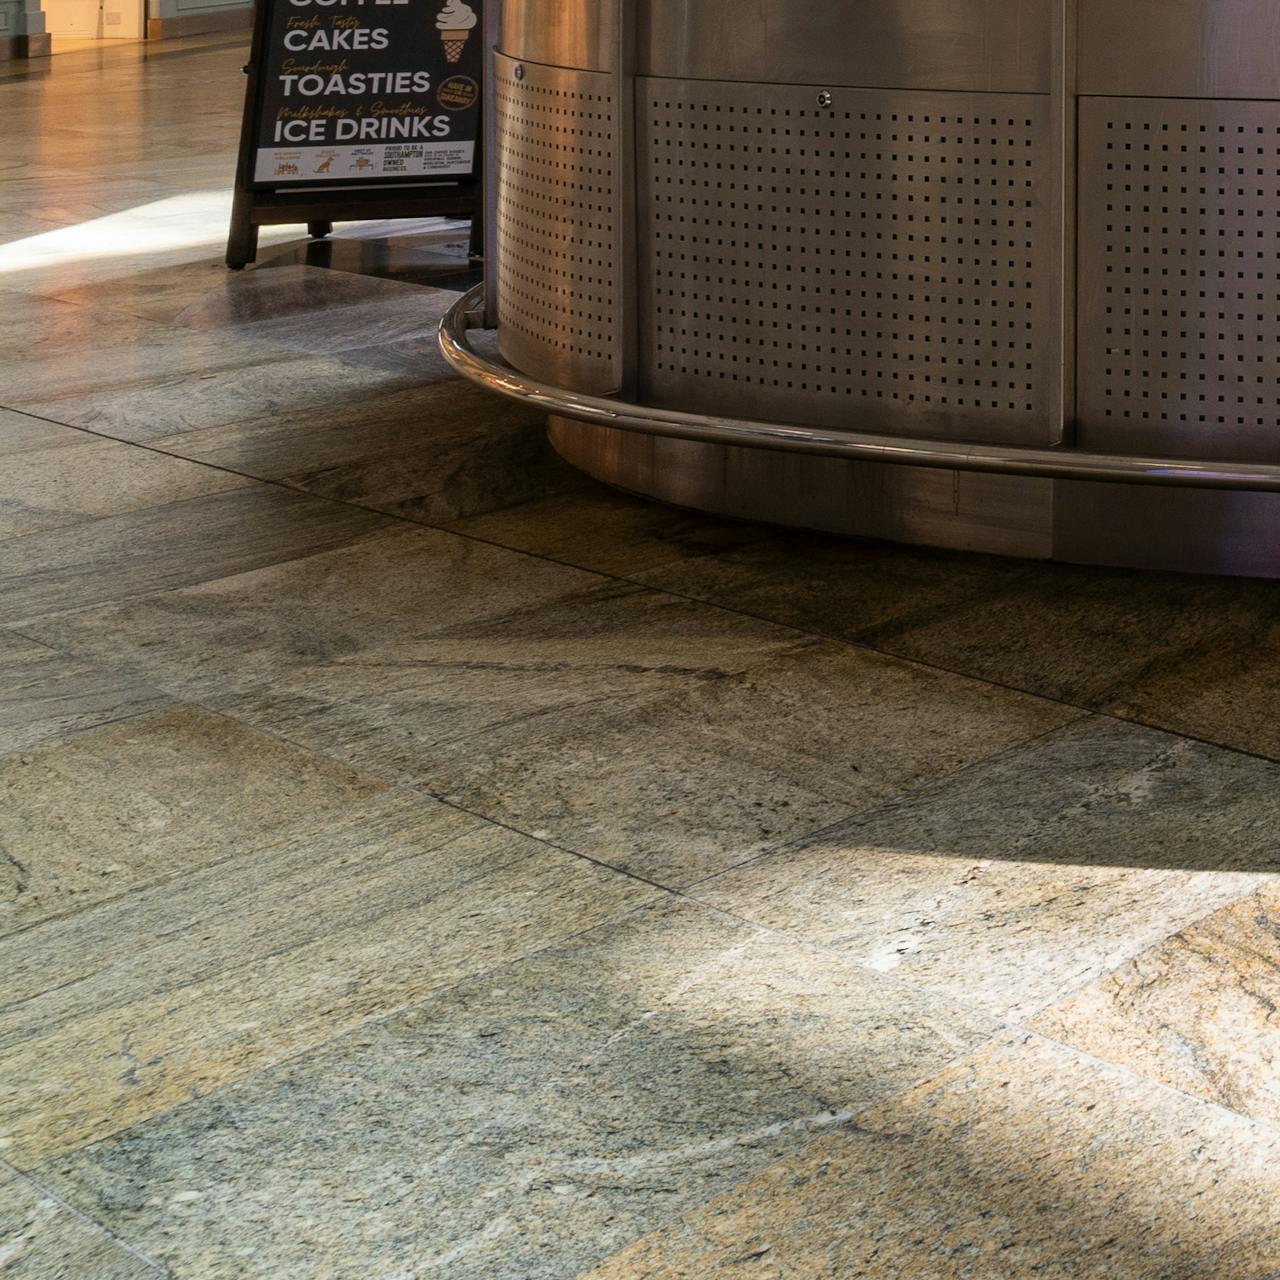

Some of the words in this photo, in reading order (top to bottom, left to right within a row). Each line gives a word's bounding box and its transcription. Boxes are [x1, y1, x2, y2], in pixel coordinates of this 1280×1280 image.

[283, 28, 389, 52] CAKES
[279, 71, 431, 97] TOASTIES
[274, 120, 326, 142] ICE
[335, 115, 450, 140] DRINKS
